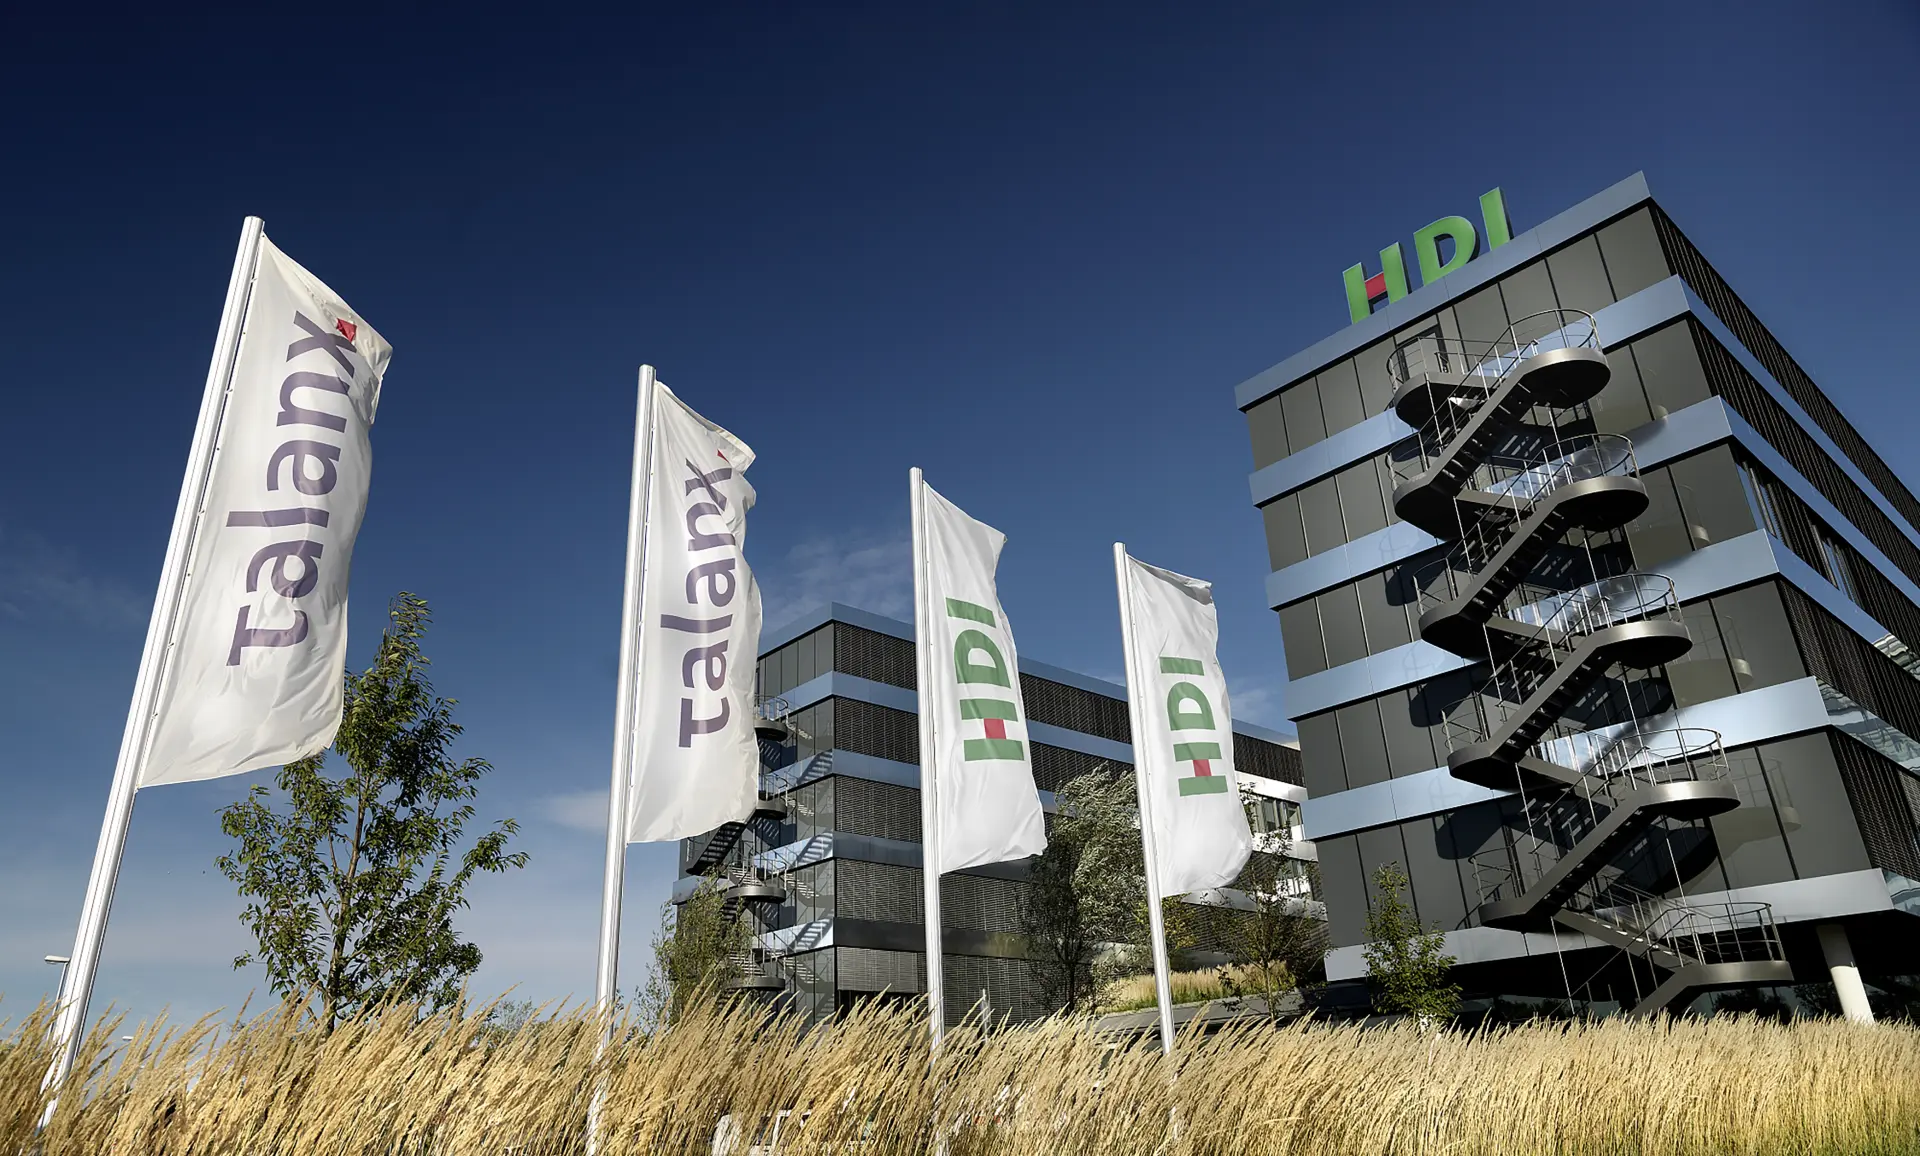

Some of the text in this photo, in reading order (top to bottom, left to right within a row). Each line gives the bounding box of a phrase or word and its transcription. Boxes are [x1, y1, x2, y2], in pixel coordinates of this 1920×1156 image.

[1342, 186, 1514, 325] HDI
[945, 597, 1025, 762] HDI
[1159, 656, 1228, 797] HDI
